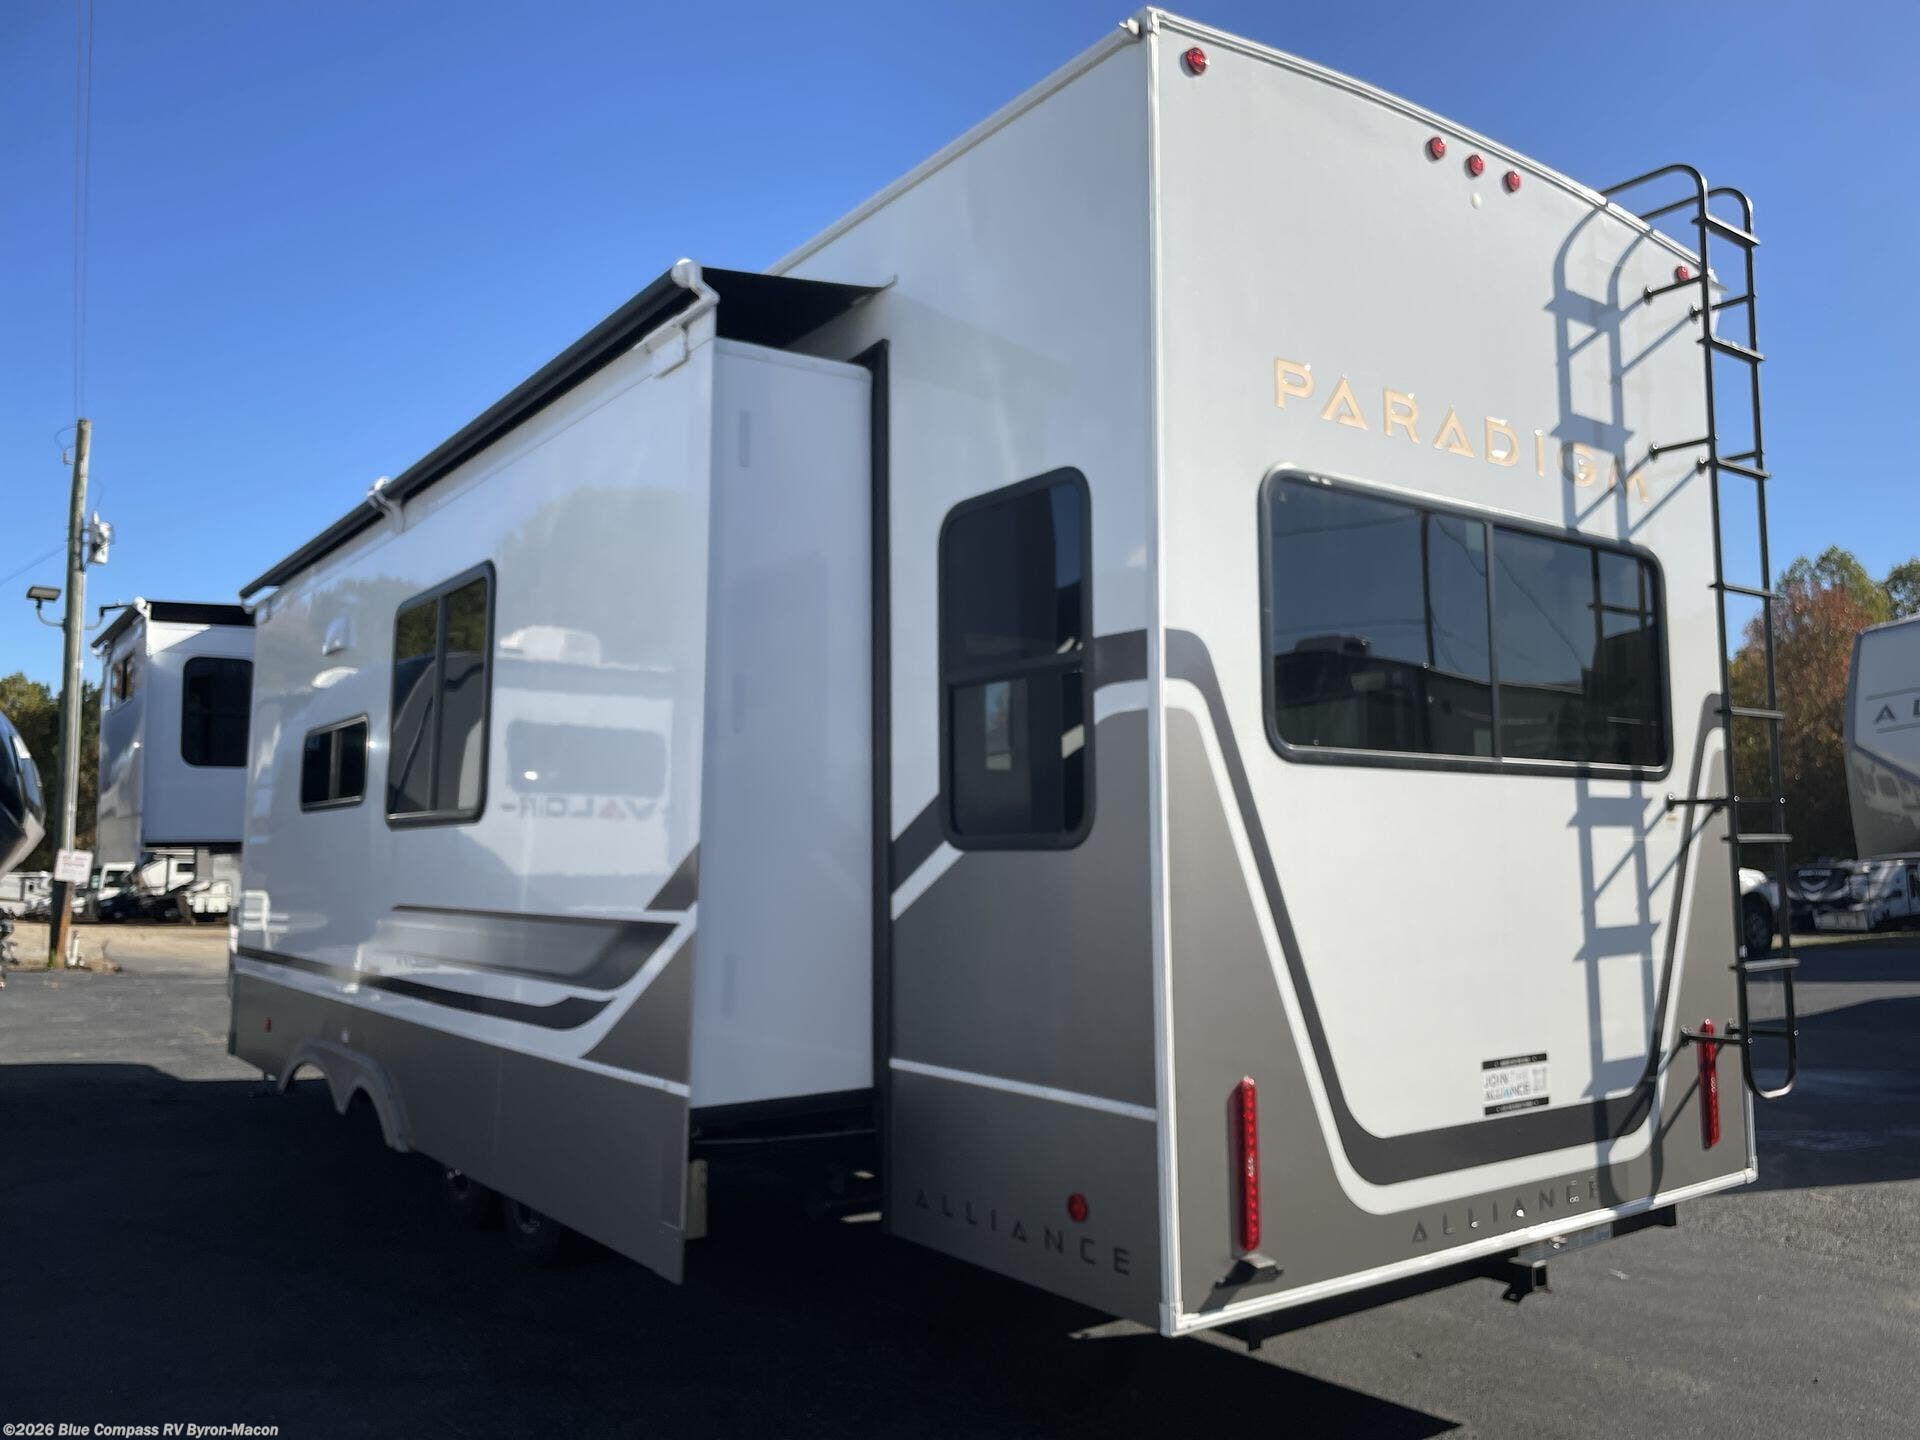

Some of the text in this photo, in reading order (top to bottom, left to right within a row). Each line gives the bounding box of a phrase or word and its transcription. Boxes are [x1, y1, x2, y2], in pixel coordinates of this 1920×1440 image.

[1273, 357, 1649, 503] PARADIGM
[1483, 1072, 1509, 1089] JOIN
[1486, 1082, 1530, 1100] ALLIANCE
[915, 1189, 1130, 1276] ALLIANCE
[1413, 1179, 1600, 1241] ALLIANCE
